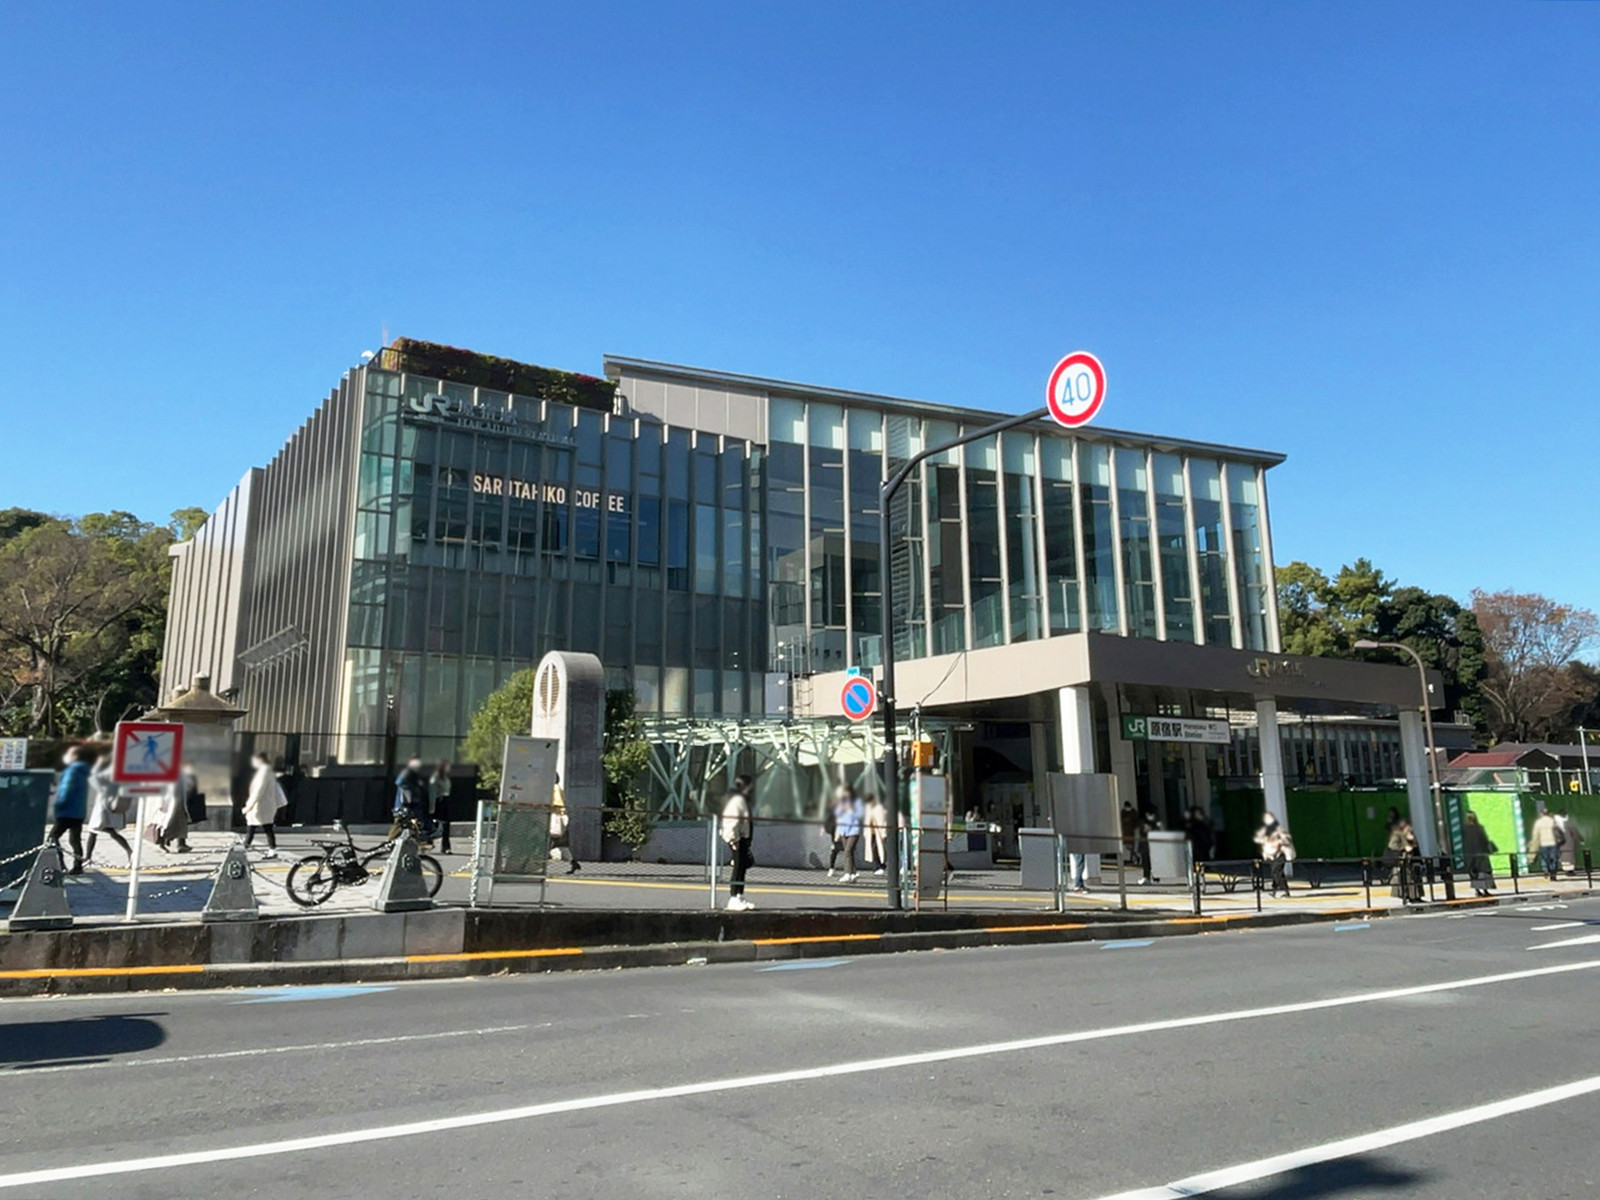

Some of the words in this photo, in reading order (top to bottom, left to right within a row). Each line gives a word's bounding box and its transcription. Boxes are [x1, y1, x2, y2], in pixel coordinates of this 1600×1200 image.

[1062, 372, 1091, 405] 40
[410, 392, 450, 416] JR
[575, 489, 625, 513] COFEE
[1128, 719, 1145, 733] JR
